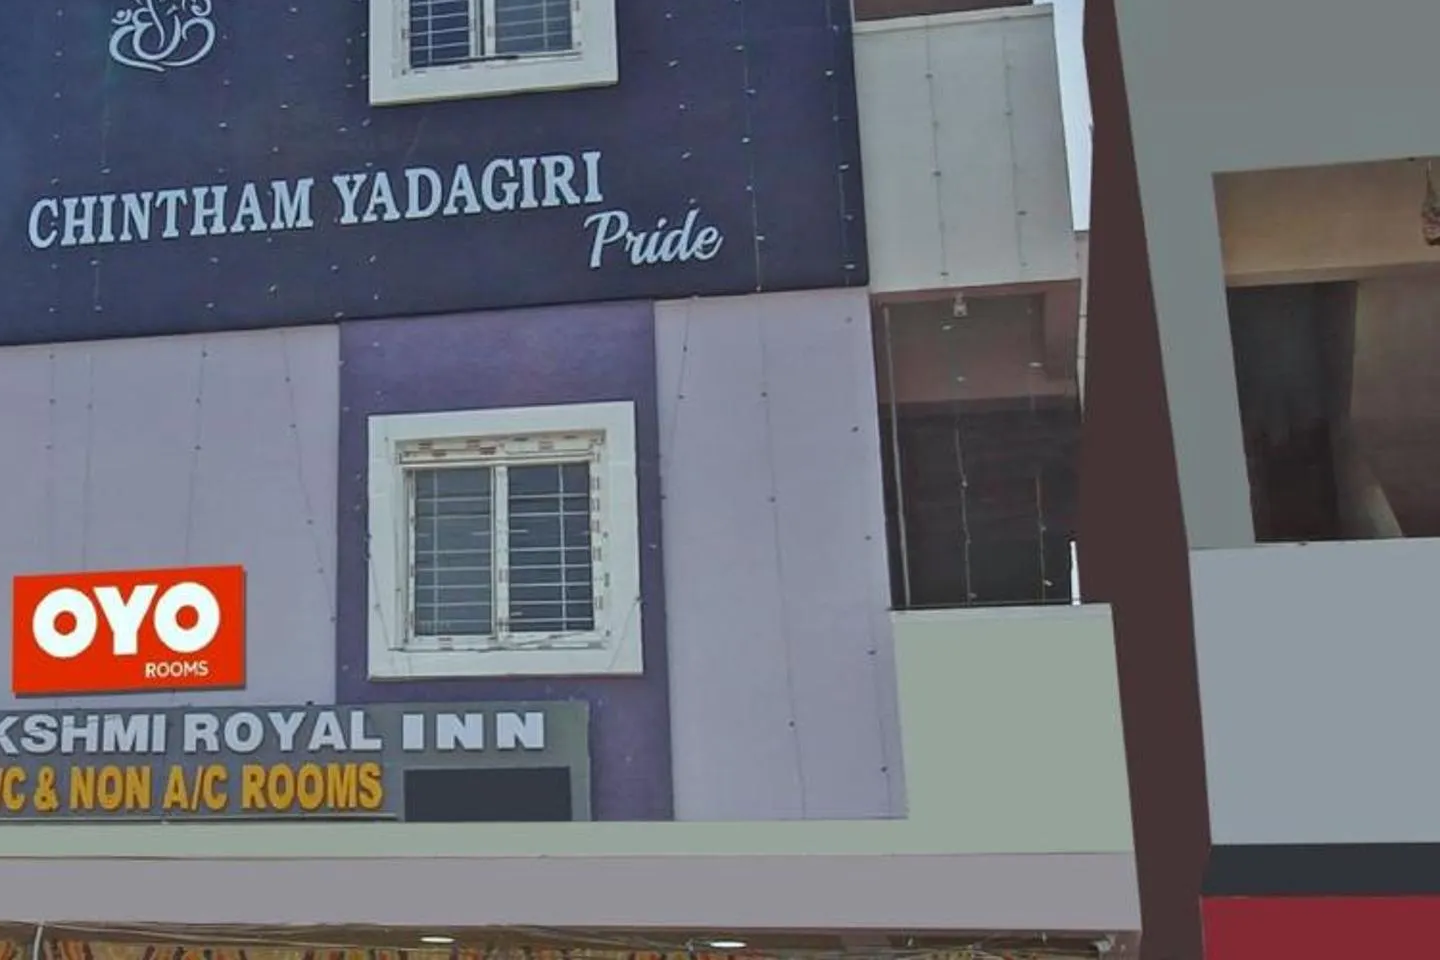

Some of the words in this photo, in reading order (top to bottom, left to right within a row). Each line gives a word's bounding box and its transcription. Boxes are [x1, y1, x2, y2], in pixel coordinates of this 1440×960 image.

[28, 176, 314, 249] CHINTHAM
[332, 150, 603, 225] YADAGIRI
[584, 208, 723, 269] Pride
[32, 581, 221, 659] OYO
[145, 659, 209, 679] ROOMS
[183, 709, 382, 753] ROYAL
[402, 711, 546, 751] INN
[33, 768, 59, 812] &
[69, 765, 152, 811] NON
[163, 764, 228, 811] A/C
[240, 762, 383, 810] ROOMS
